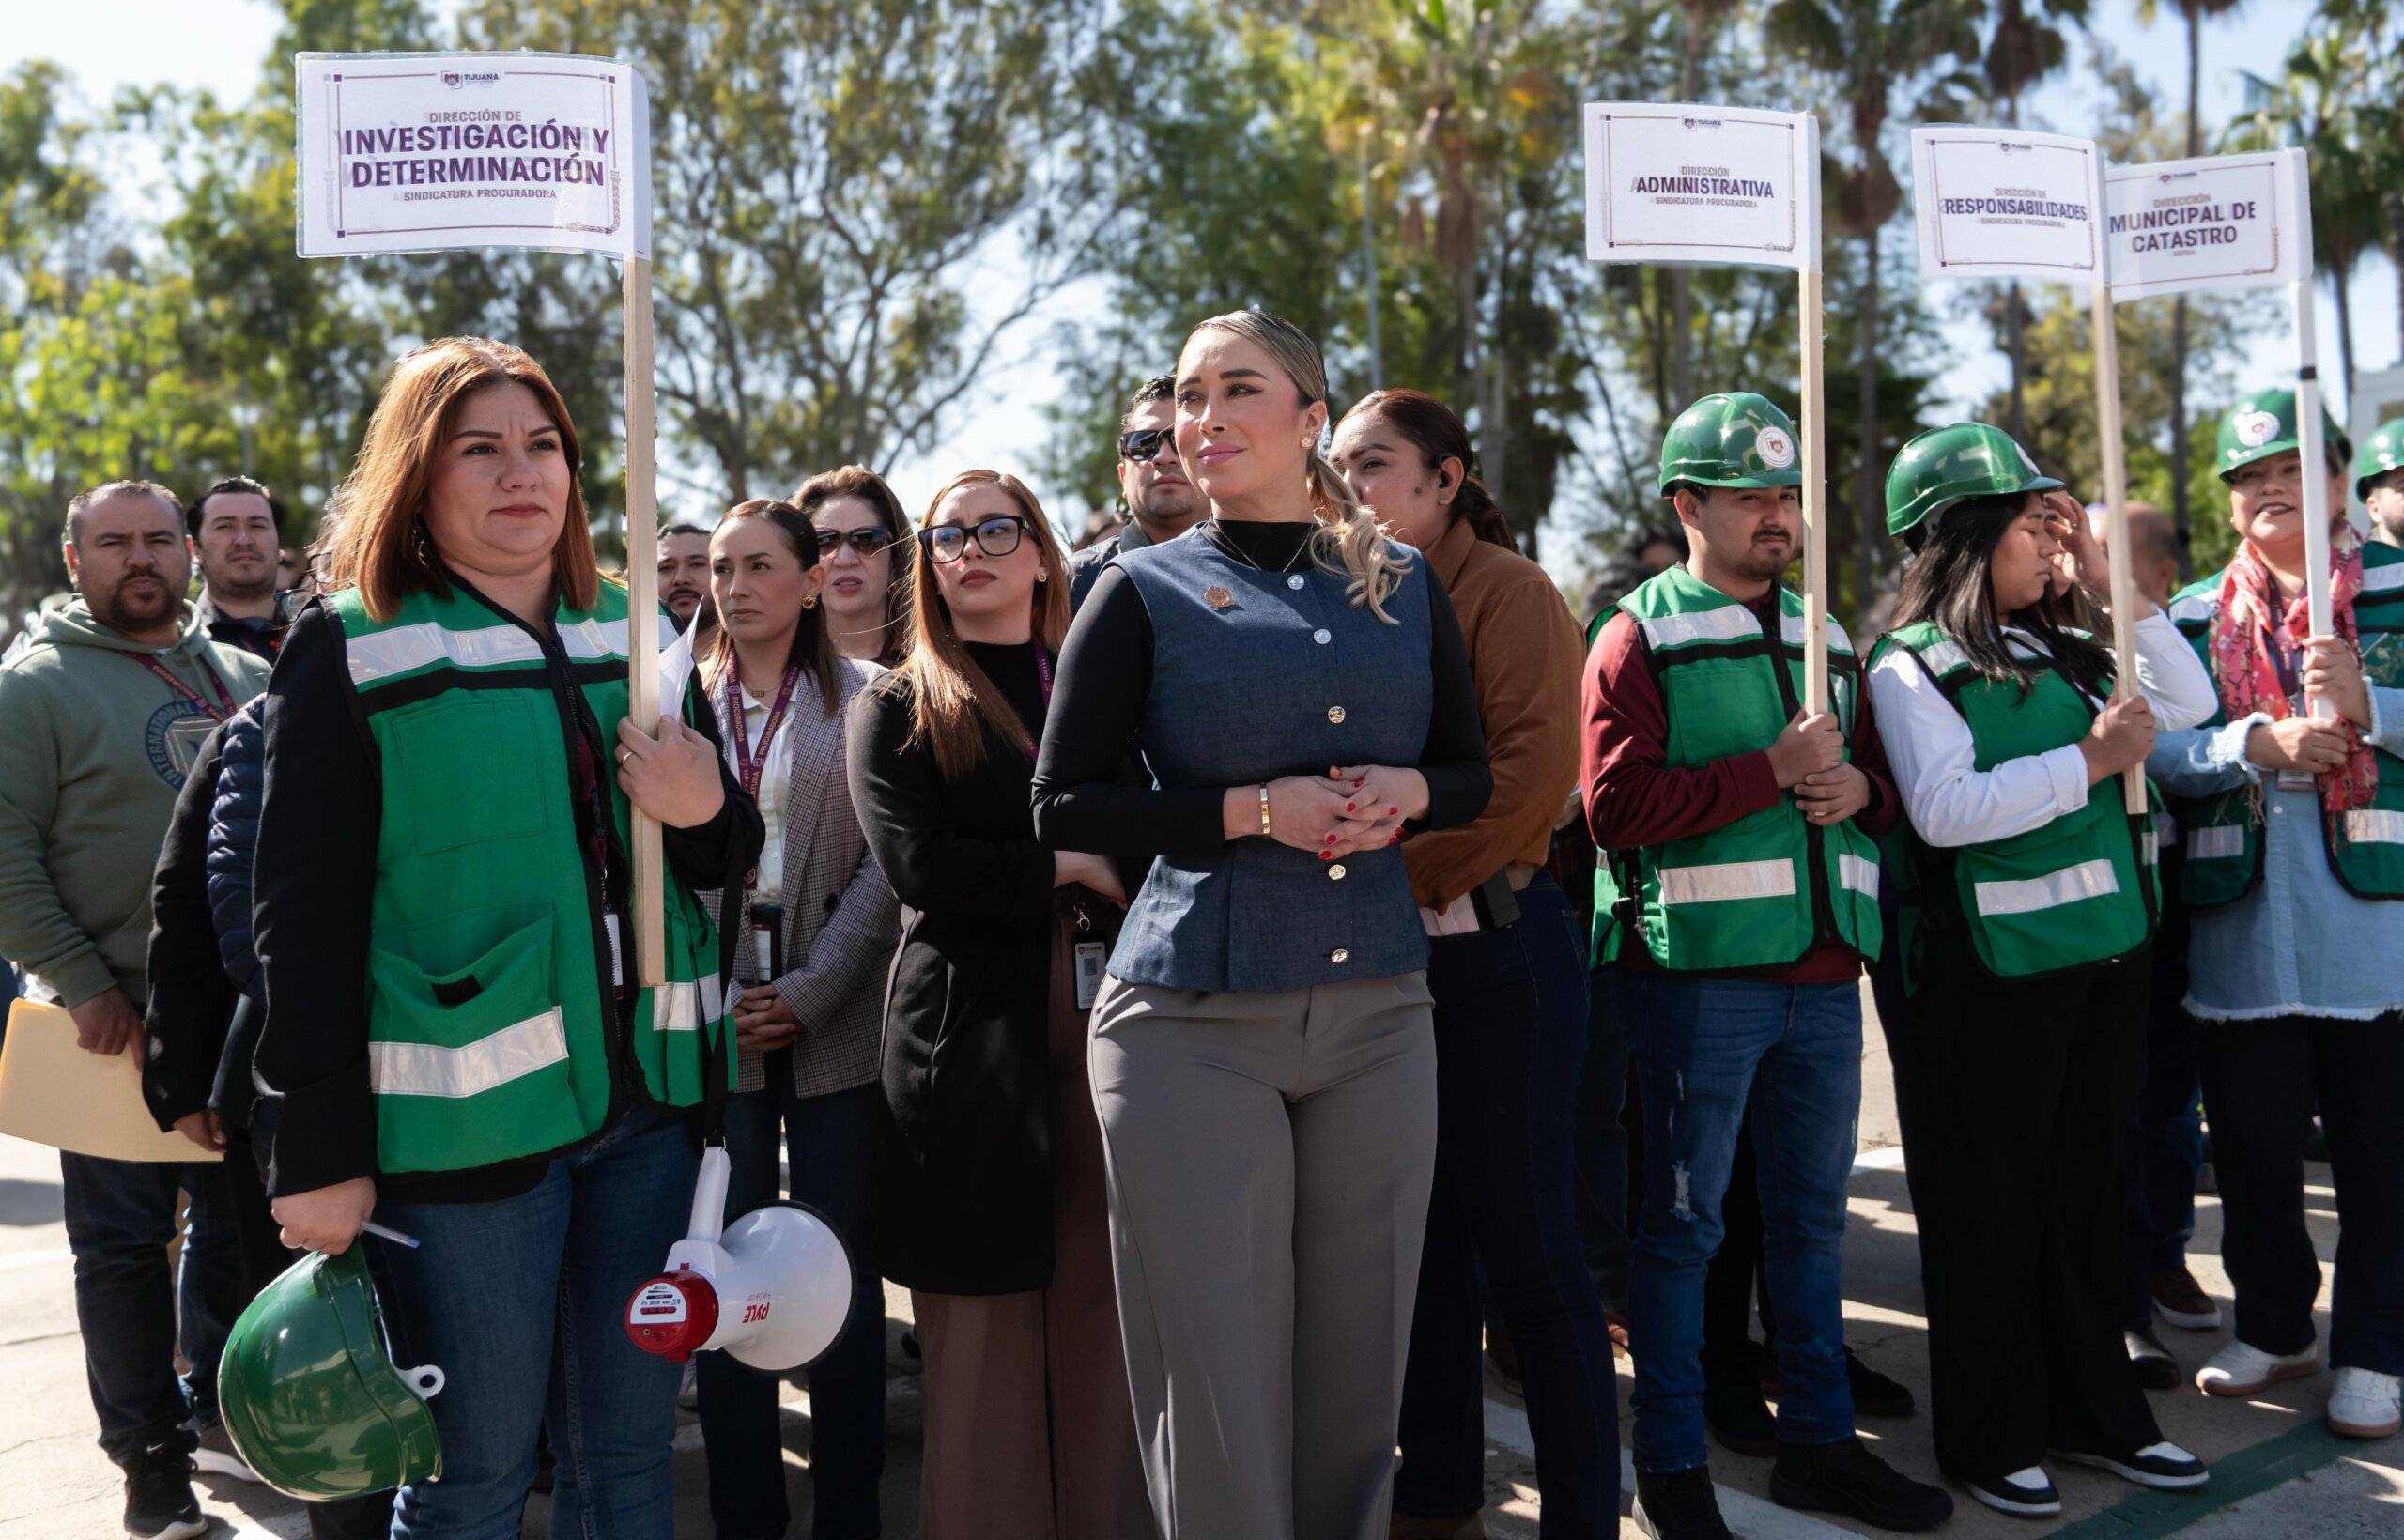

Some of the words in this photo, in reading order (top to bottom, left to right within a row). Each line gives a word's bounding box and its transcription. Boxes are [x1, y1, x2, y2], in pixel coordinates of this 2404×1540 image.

[429, 109, 501, 124] DIRECCIÓN
[505, 110, 522, 122] DE
[345, 118, 582, 156] INVESTIGACIÓN
[593, 129, 610, 155] Y
[352, 151, 605, 188] DETERMINACIÓN
[1681, 165, 1730, 177] DIRECCIÓN
[404, 190, 474, 202] SINDICATURA
[477, 188, 557, 200] PROCURADORA
[1636, 177, 1774, 198] ADMINISTRATIVA
[1656, 196, 1704, 206] SINDICATURA
[1706, 198, 1758, 208] PROCURADORA
[1945, 198, 2088, 221] RESPONSABILIDADES
[2153, 192, 2211, 208] DIRECCIÓN
[2109, 205, 2224, 234] MUNICIPAL
[2233, 201, 2257, 220] DE
[2133, 225, 2237, 253] CATASTRO
[732, 696, 745, 743] PROCURADORA
[147, 701, 195, 786] INTERNATIONAL
[758, 710, 782, 756] PROCURADORA
[743, 1302, 770, 1324] PYLE
